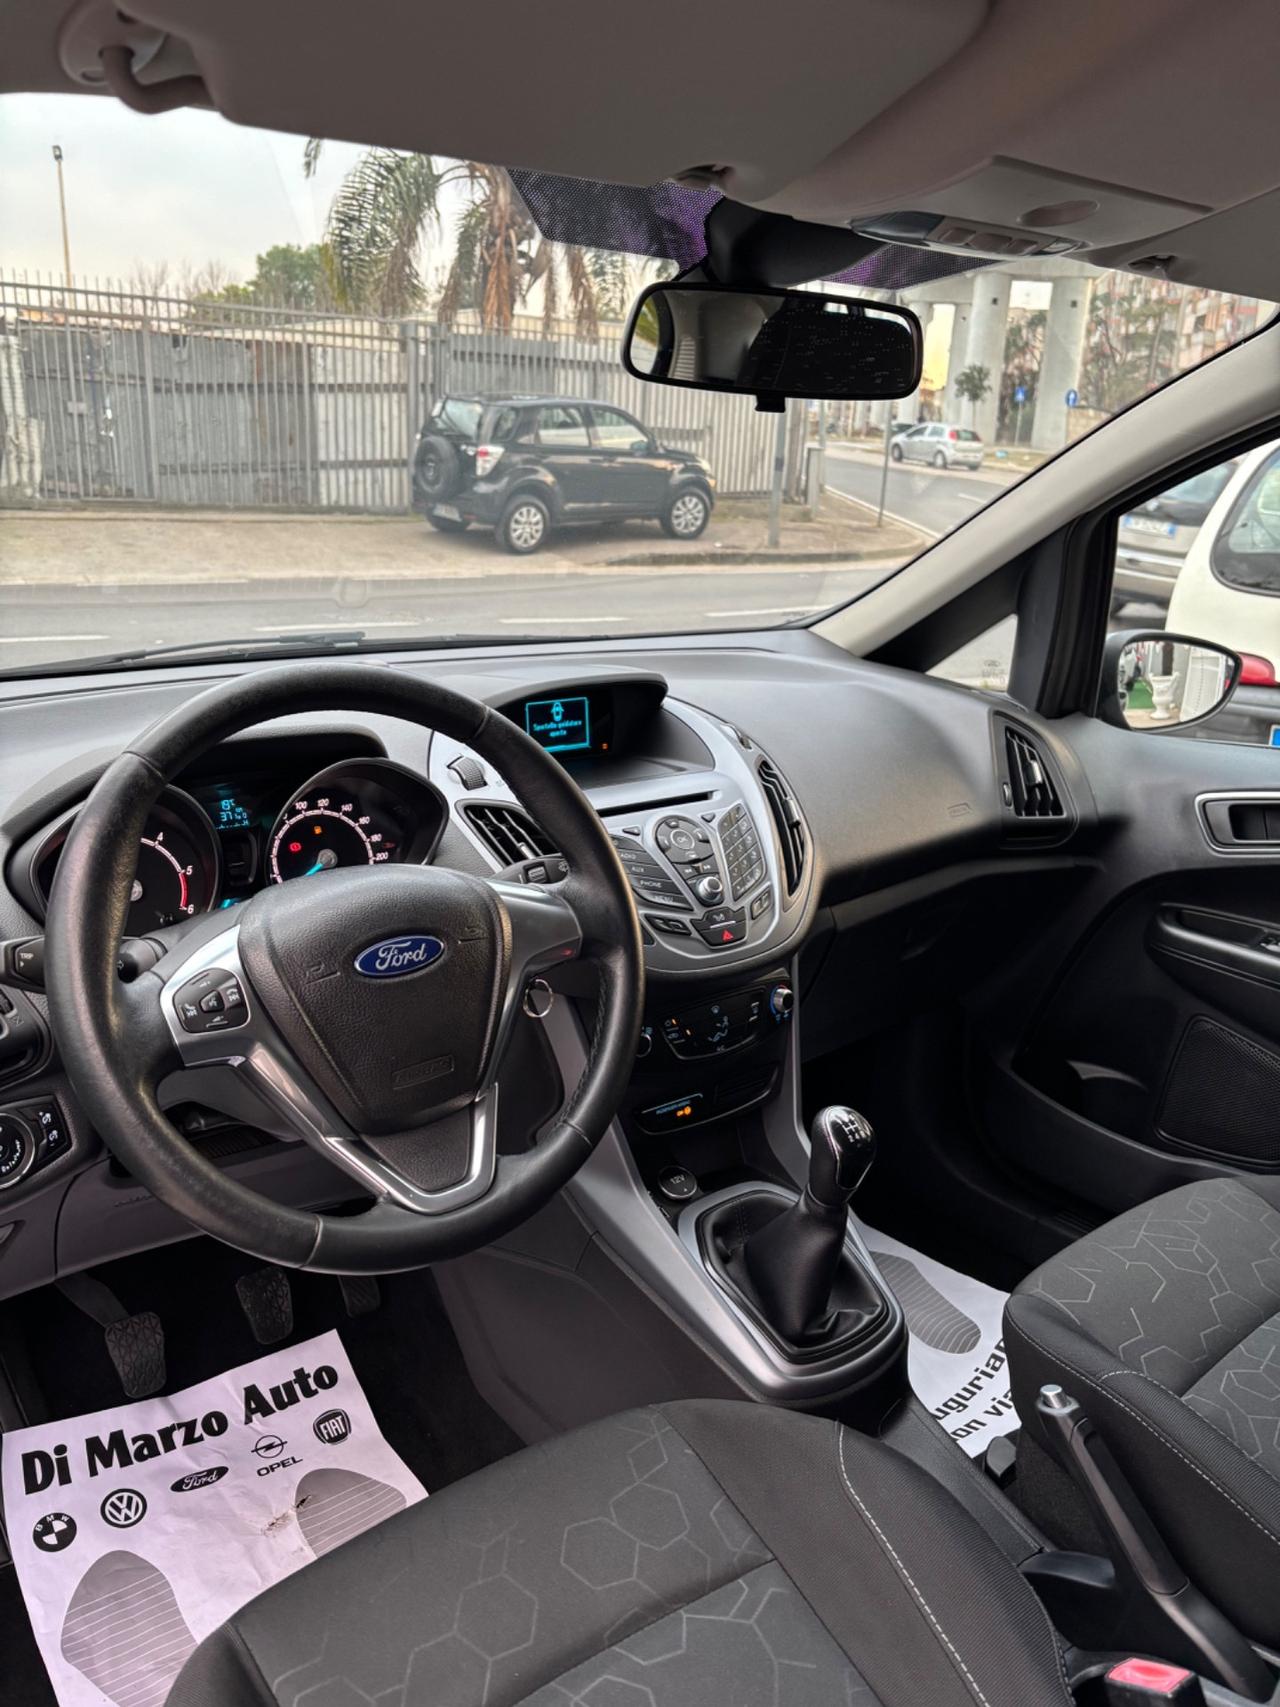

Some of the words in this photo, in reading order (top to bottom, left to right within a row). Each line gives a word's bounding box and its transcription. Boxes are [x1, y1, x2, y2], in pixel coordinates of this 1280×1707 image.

[295, 801, 308, 810] 100
[156, 832, 164, 841] 4
[375, 852, 389, 861] 200
[185, 865, 193, 875] 5
[186, 904, 195, 914] 6
[375, 941, 427, 971] Ford
[21, 1444, 73, 1496] Di
[85, 1410, 229, 1477] Marzo
[242, 1364, 339, 1426] Auto
[319, 1415, 347, 1441] FIAT
[256, 1456, 304, 1477] OPEL
[182, 1470, 219, 1491] Ford
